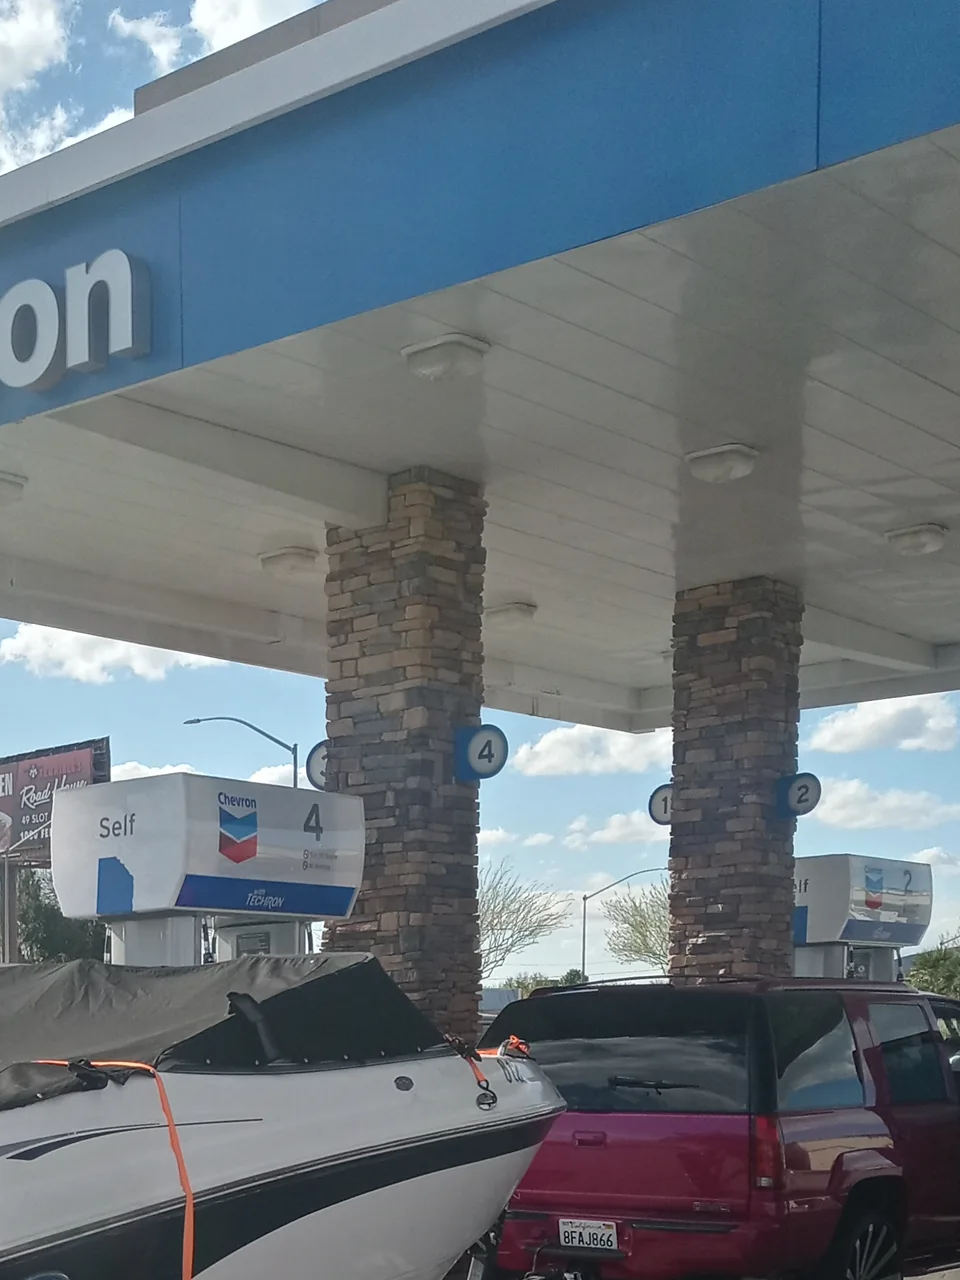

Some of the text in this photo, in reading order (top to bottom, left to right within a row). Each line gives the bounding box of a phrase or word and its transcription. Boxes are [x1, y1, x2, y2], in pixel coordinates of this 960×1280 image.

[478, 740, 495, 763] 4
[20, 782, 51, 809] Road
[796, 784, 810, 804] 2
[661, 796, 668, 815] 1
[31, 812, 49, 824] SLOT
[99, 813, 136, 838] Self
[217, 791, 324, 842] Chevron 4
[245, 893, 285, 909] TECHRON
[563, 1230, 613, 1248] 8FAJ866
